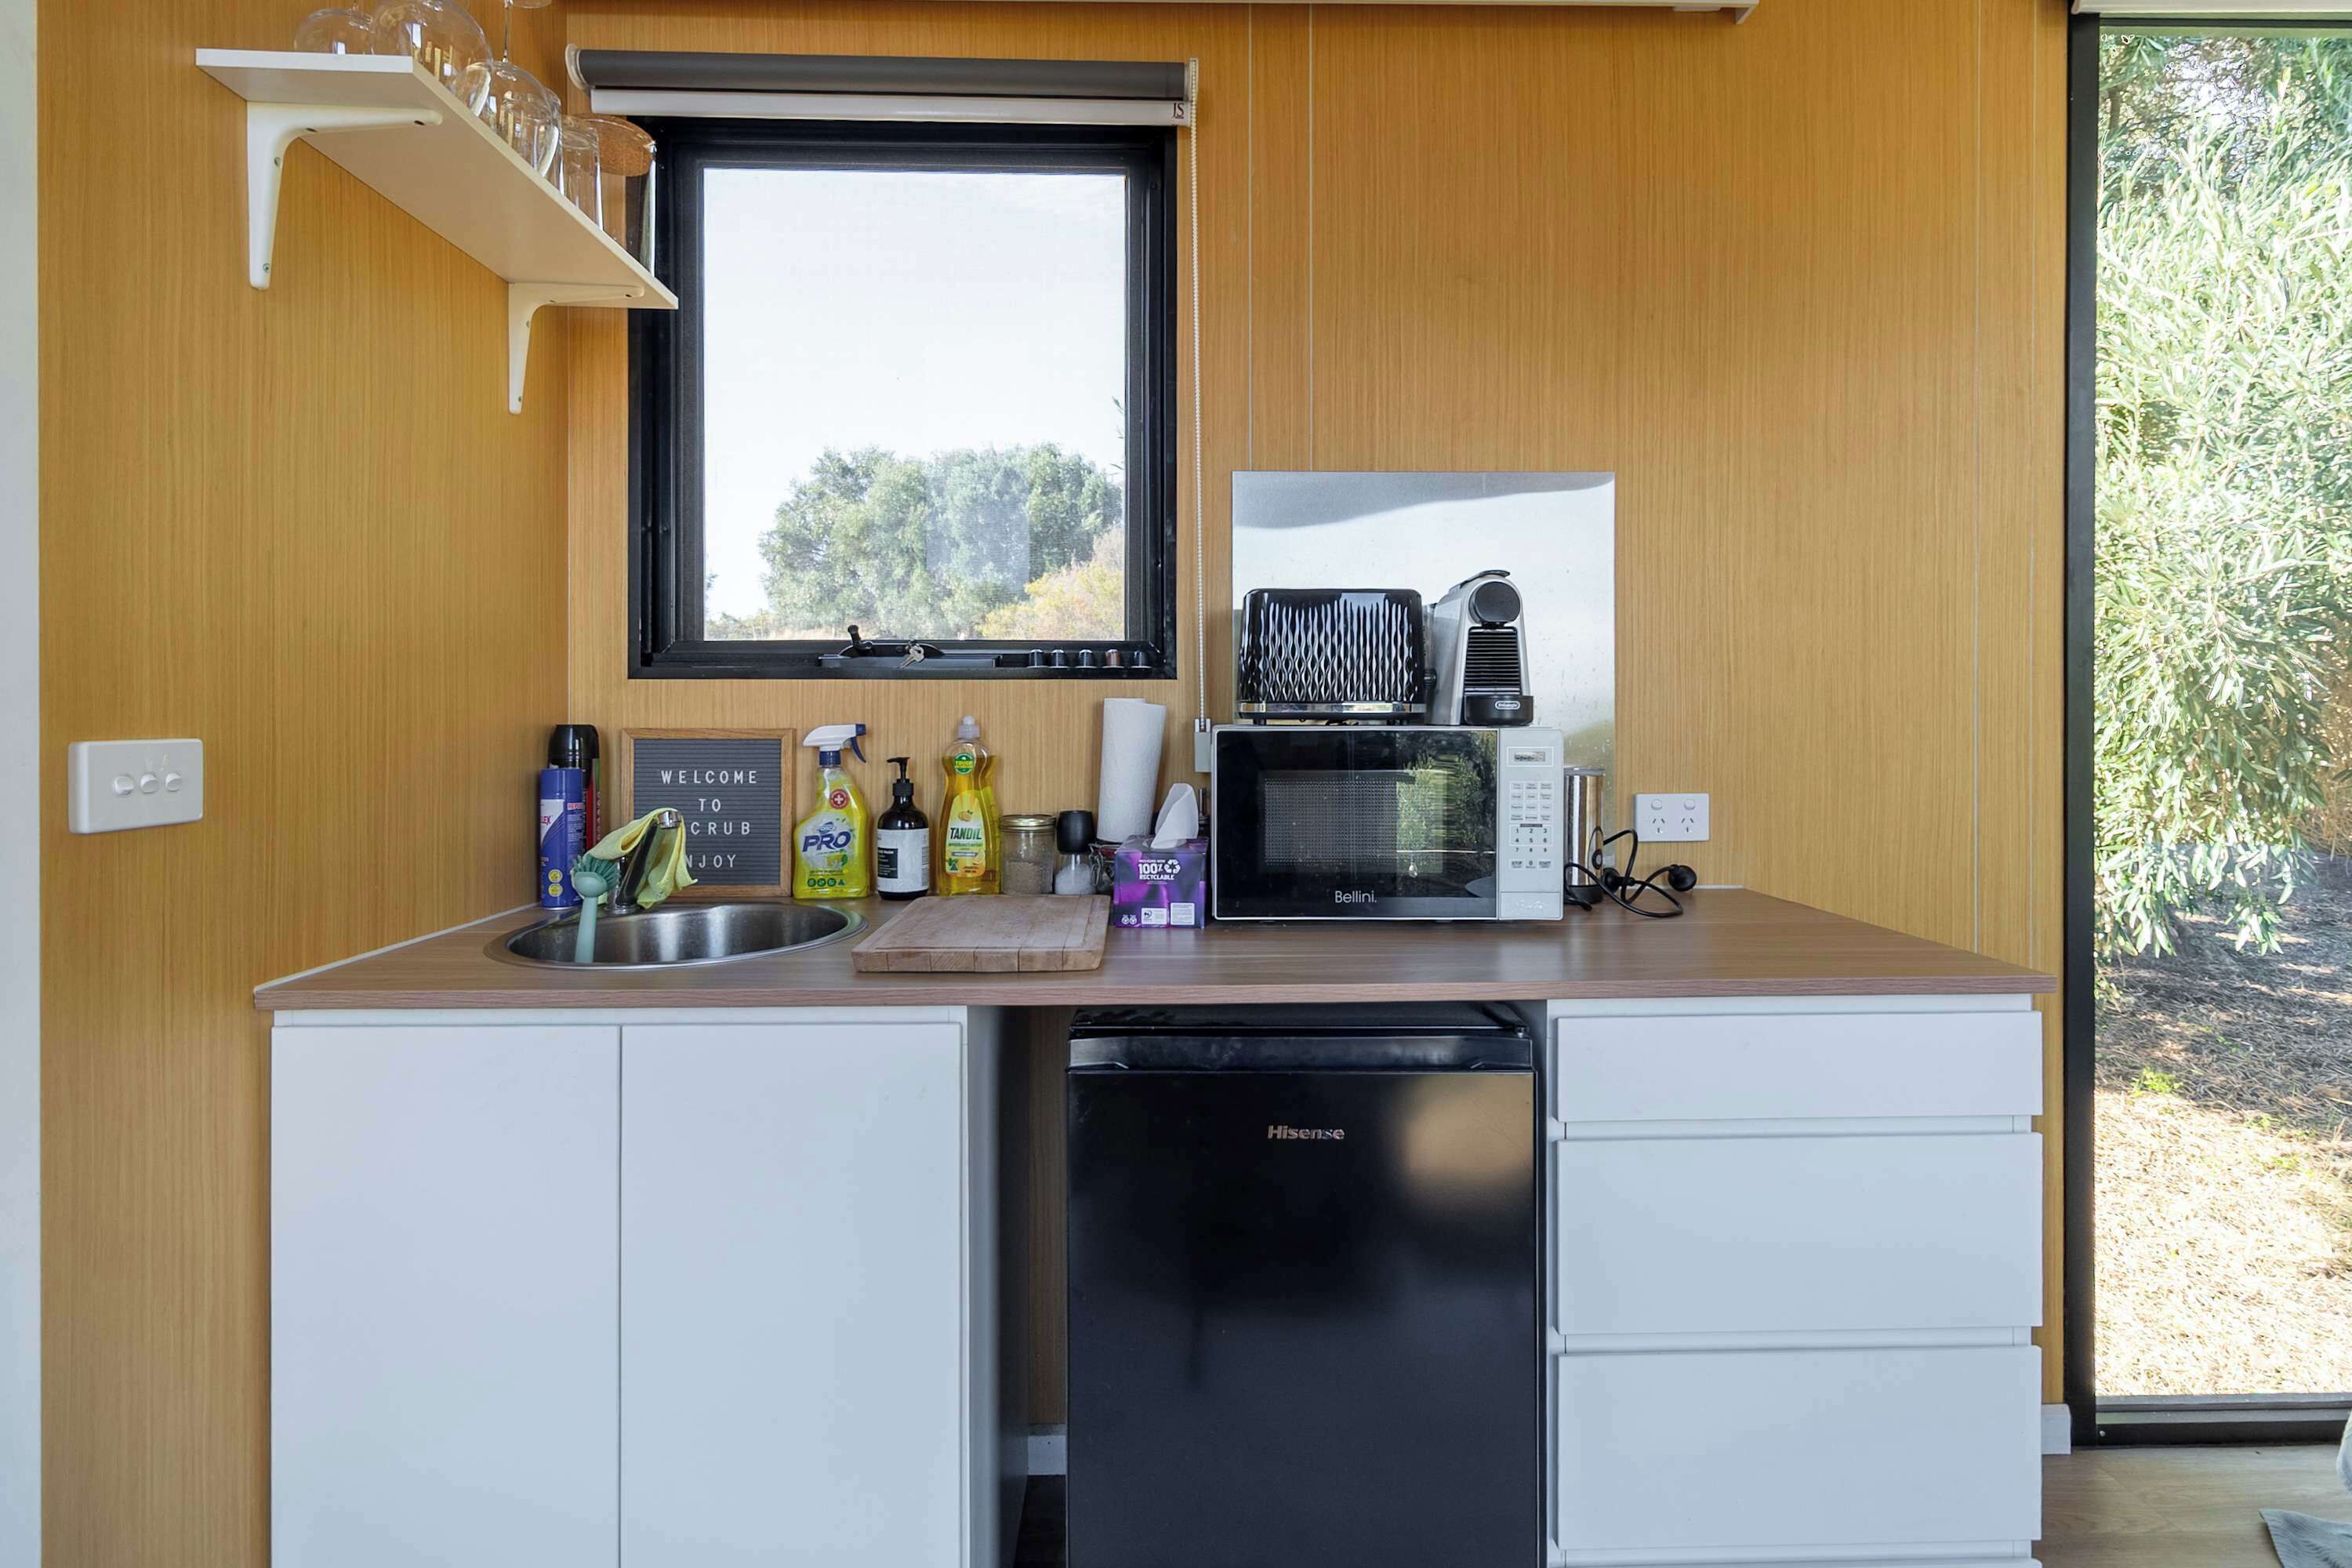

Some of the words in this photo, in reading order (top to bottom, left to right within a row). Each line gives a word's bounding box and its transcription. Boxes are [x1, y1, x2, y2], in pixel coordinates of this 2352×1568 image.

[661, 770, 757, 784] WELCOME
[699, 798, 721, 812] TO
[691, 822, 750, 835] CRUB
[802, 831, 851, 853] PRO
[685, 854, 736, 868] NJOY
[1138, 863, 1163, 874] 100%
[1268, 1125, 1345, 1139] Hisense
